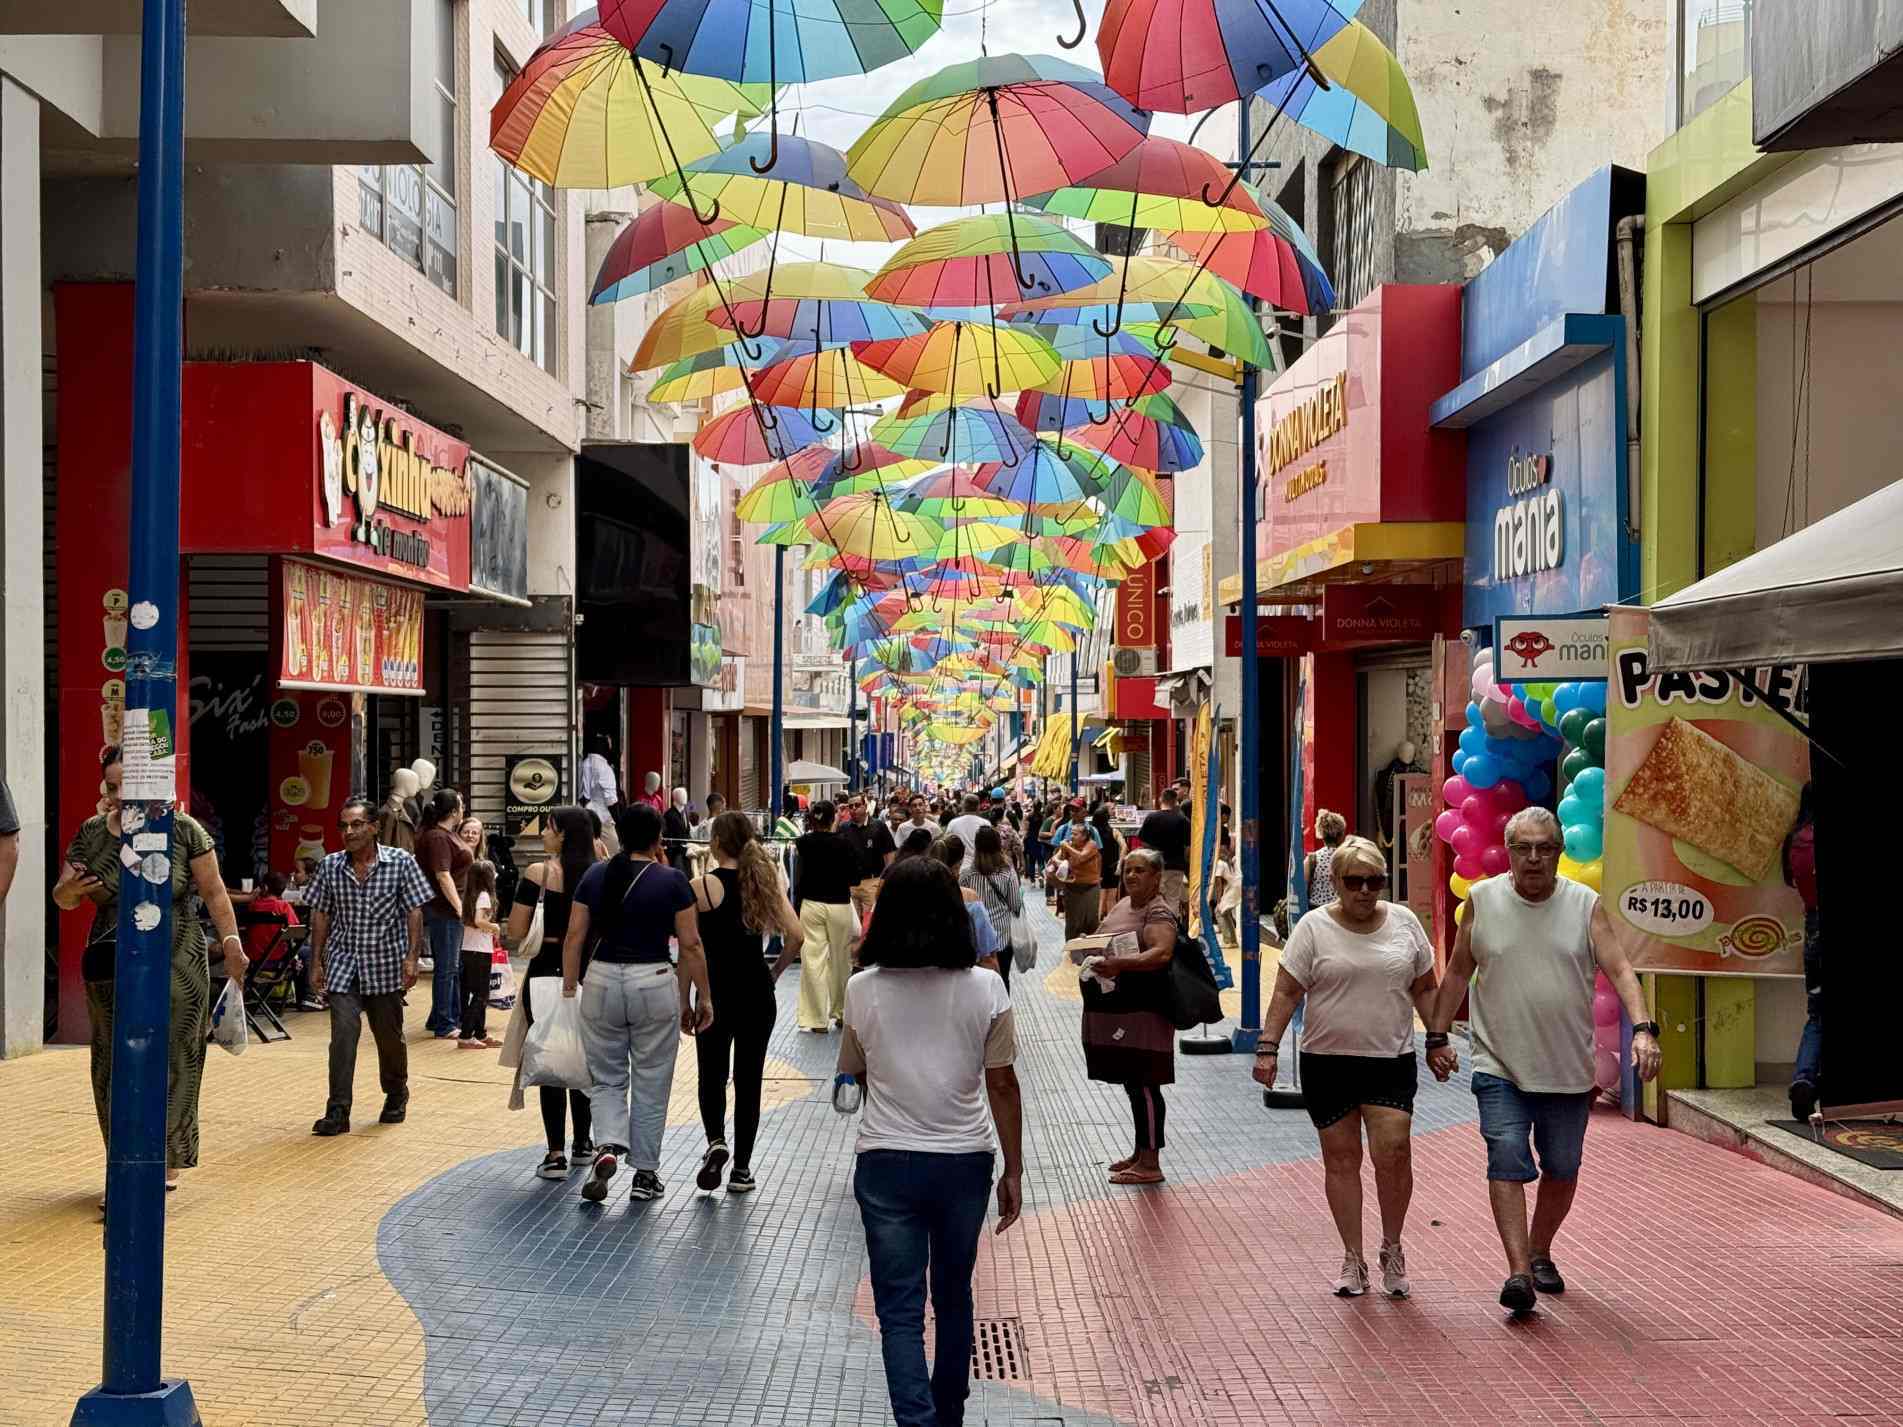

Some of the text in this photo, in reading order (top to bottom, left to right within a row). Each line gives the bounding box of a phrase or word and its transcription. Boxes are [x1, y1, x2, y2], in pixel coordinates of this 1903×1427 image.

[1269, 373, 1347, 479] DONNA VIOLETA
[345, 417, 432, 520] Cxinha
[1494, 488, 1563, 582] mania
[1127, 573, 1148, 640] ÚNICO
[1336, 618, 1422, 628] DONNA VIOLETA
[1266, 640, 1298, 649] VIOLETA
[507, 805, 538, 813] COMPRO
[1628, 896, 1704, 922] R$ 13,00
